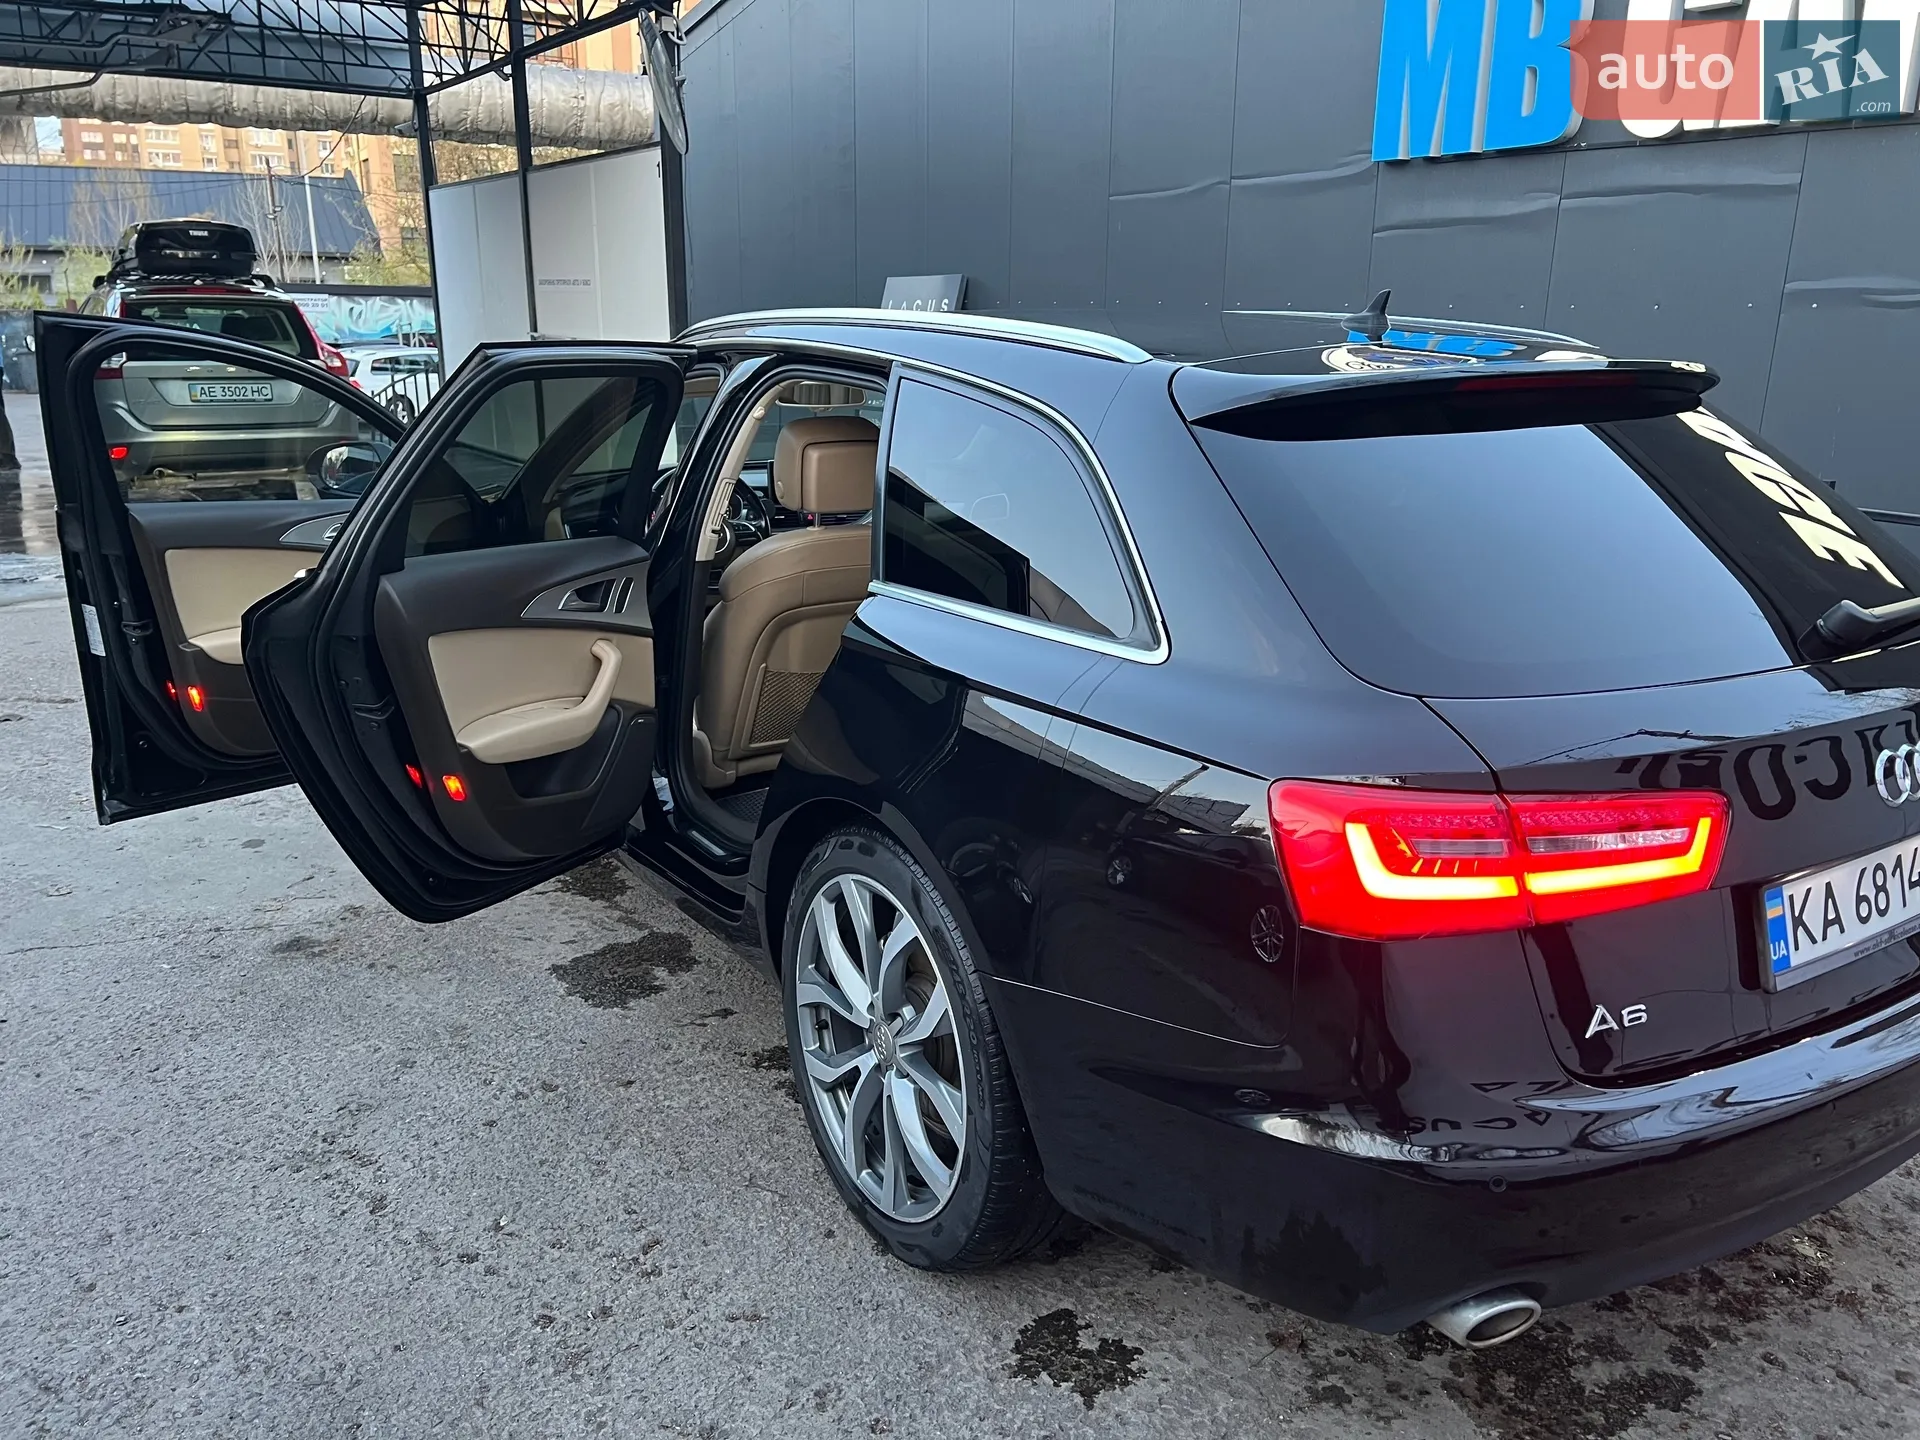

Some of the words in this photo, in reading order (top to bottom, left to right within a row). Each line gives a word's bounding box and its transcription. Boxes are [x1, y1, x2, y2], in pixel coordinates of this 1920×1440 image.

[1372, 0, 1590, 162] MB
[200, 386, 218, 398] AE
[220, 386, 249, 398] 3502
[250, 386, 269, 397] HC
[1788, 880, 1846, 952] KA
[1854, 846, 1920, 925] 6814
[1770, 939, 1788, 960] UA
[1584, 1003, 1648, 1039] A6
